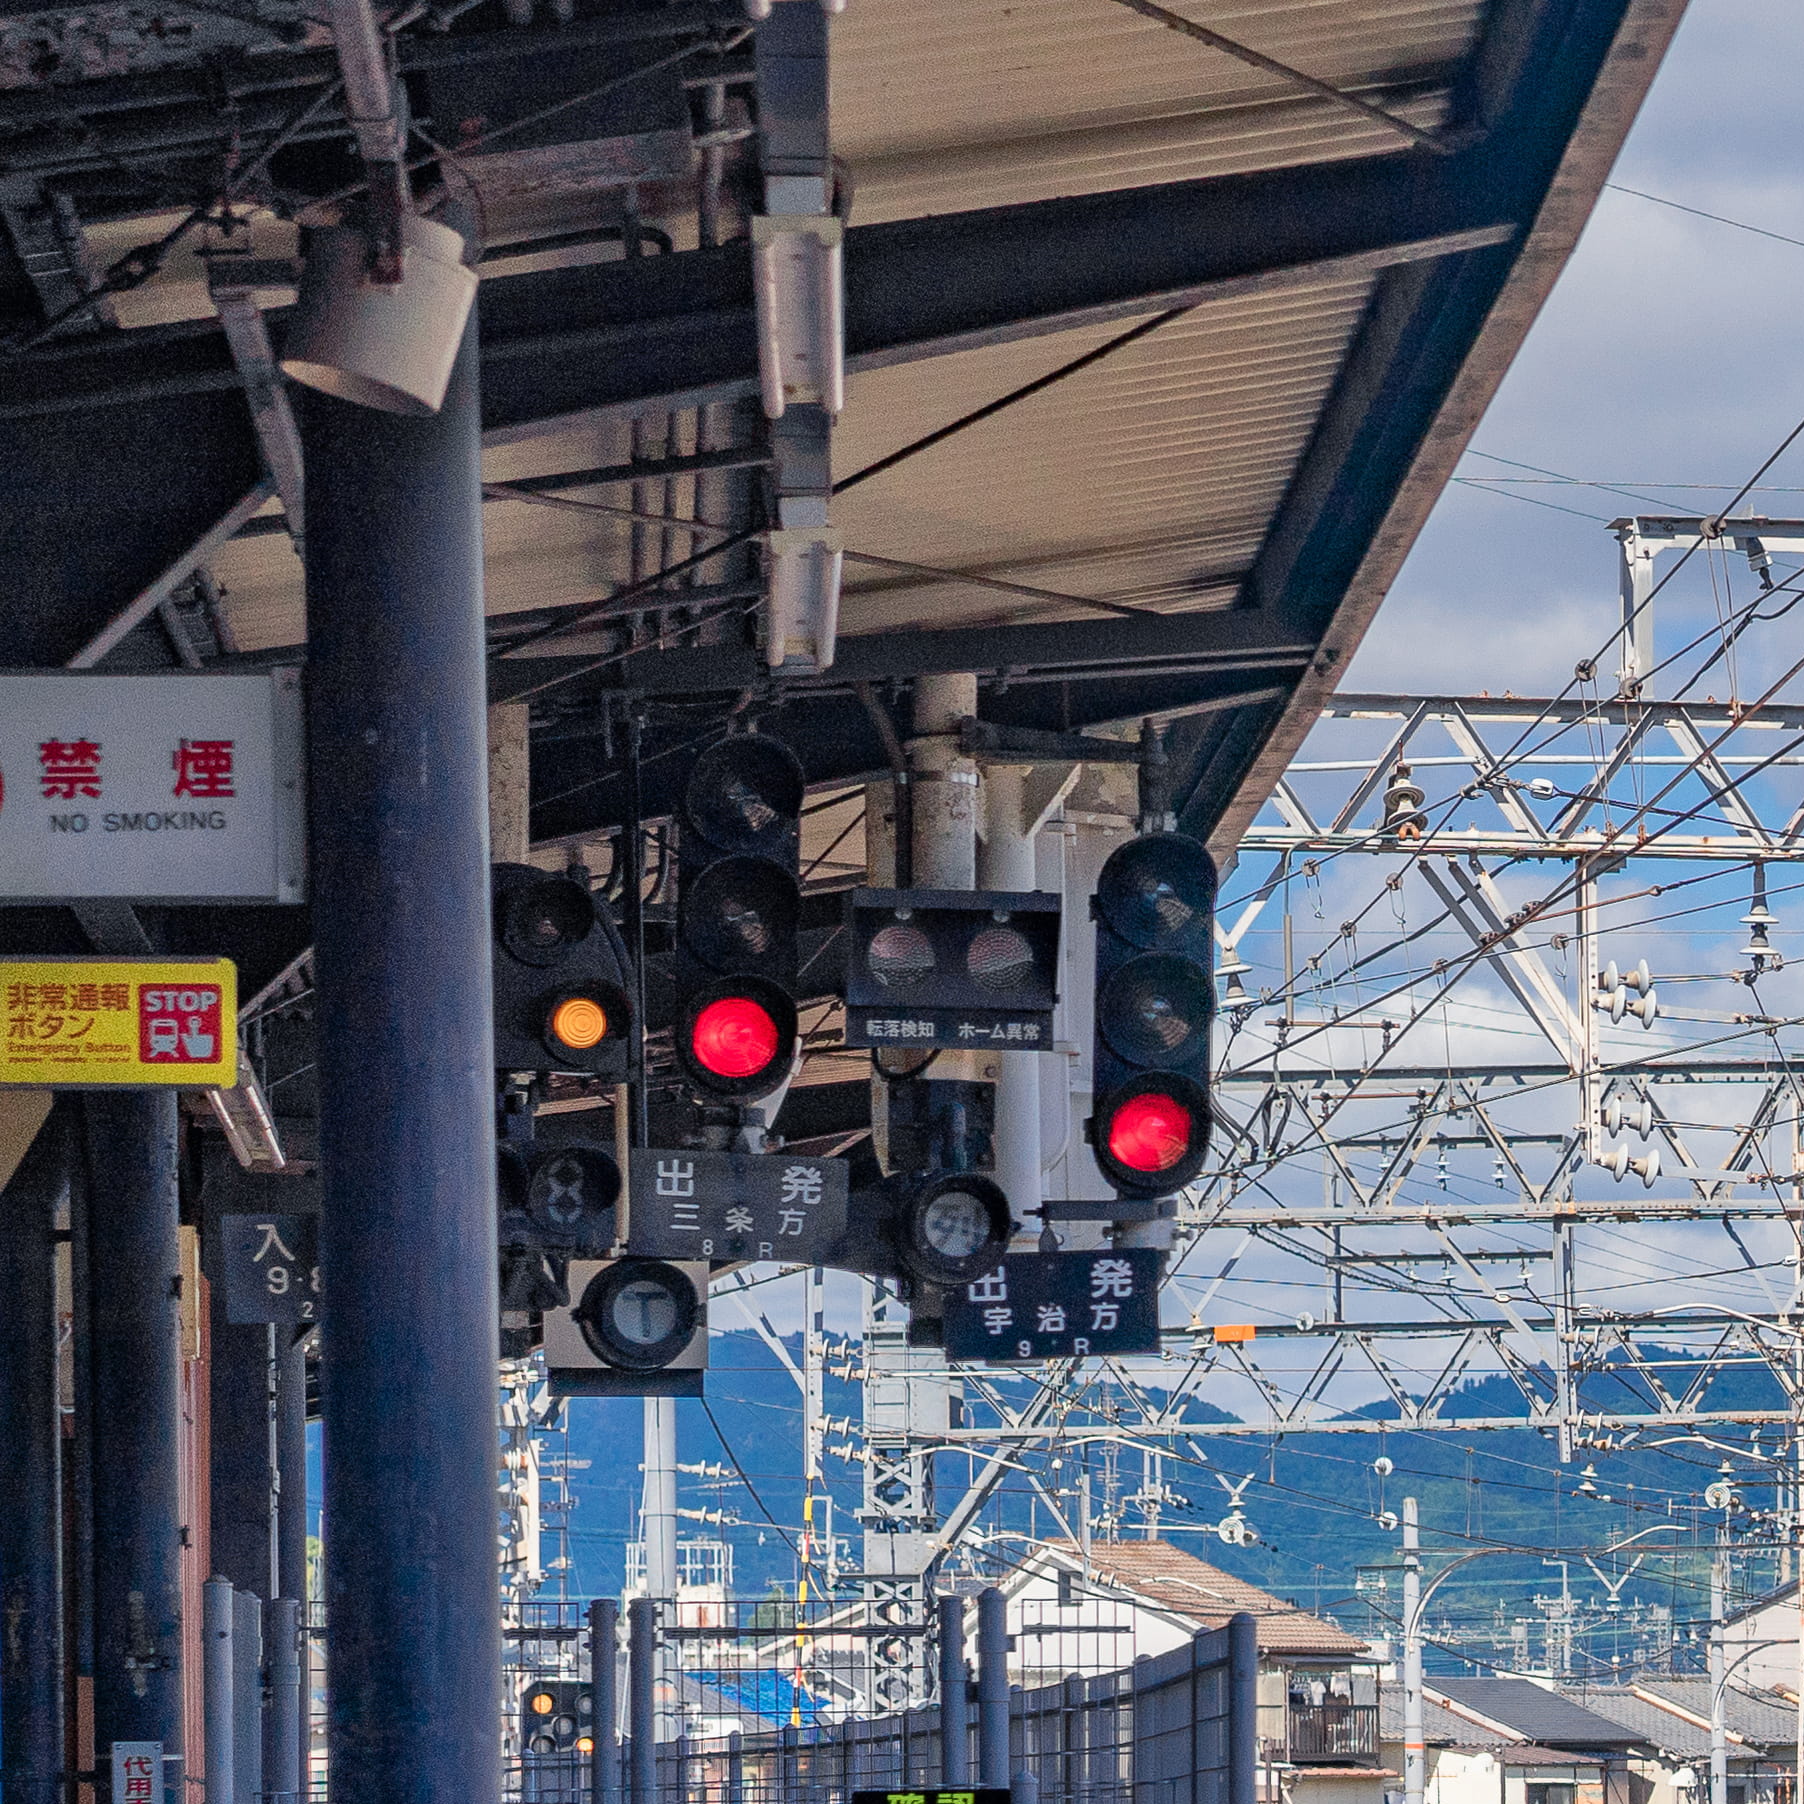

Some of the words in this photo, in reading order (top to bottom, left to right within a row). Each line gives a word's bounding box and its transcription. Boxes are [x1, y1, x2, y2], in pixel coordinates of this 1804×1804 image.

[40, 737, 235, 799] 禁煙
[51, 814, 88, 833] NO
[103, 811, 227, 832] SMOKING
[8, 982, 130, 1011] 非常通報
[146, 990, 217, 1012] STOP
[7, 1013, 94, 1038] ボタン
[866, 1020, 934, 1037] 転落検知
[958, 1022, 1040, 1040] ホーム異常
[85, 1042, 130, 1053] Button
[656, 1159, 823, 1205] 出発
[670, 1203, 807, 1235] 三条方
[702, 1239, 714, 1255] 8
[759, 1242, 773, 1259] R
[968, 1259, 1133, 1302] 出発
[983, 1302, 1120, 1335] 宇治方
[1018, 1340, 1032, 1357] 9
[1074, 1337, 1090, 1355] R
